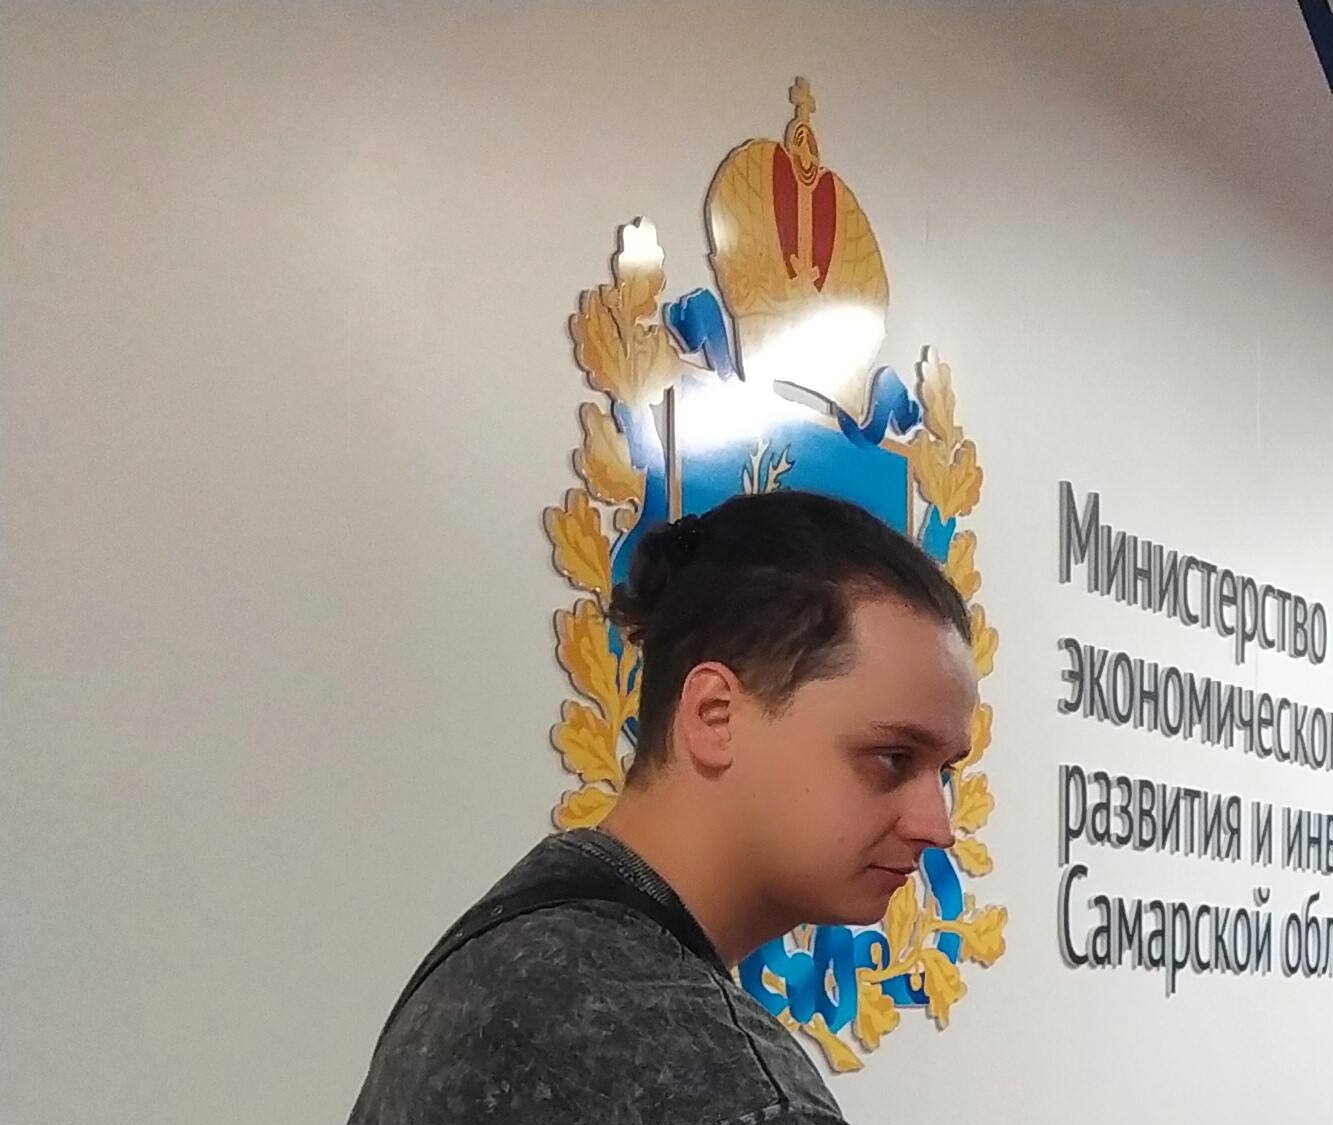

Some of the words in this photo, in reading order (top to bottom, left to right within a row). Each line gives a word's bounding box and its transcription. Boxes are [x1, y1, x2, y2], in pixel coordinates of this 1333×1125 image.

[1058, 480, 1327, 664] Министерство
[1058, 764, 1241, 867] развития
[1251, 802, 1273, 866] и
[1058, 864, 1271, 997] Самарской
